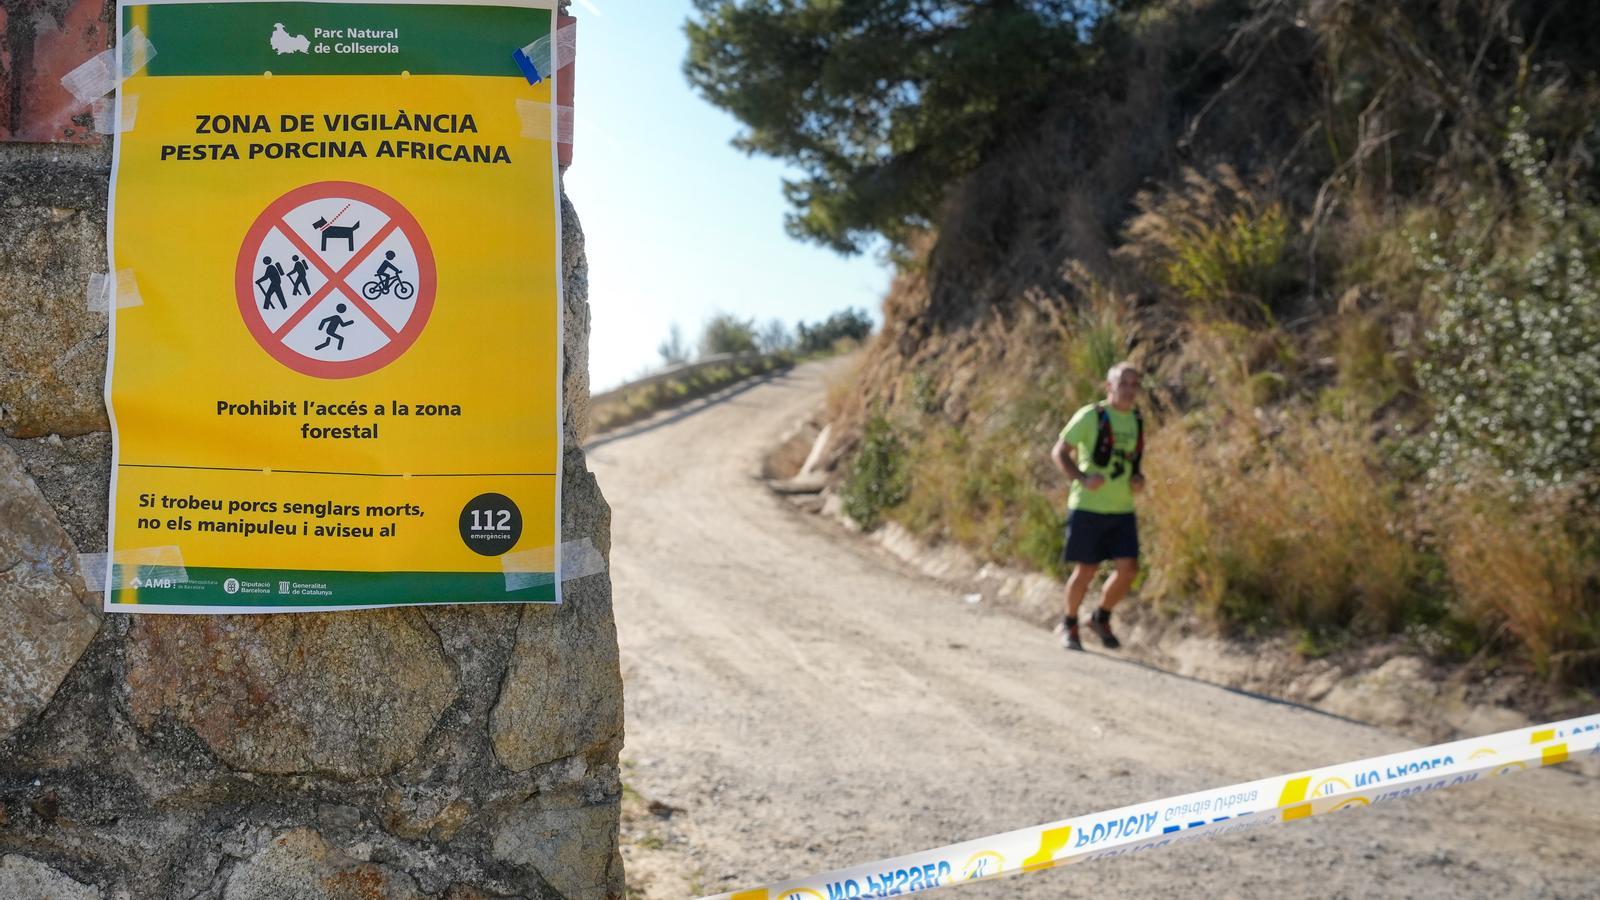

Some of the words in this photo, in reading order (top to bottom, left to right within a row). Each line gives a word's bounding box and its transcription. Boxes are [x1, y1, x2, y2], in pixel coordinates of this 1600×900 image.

[314, 28, 343, 38] Parc
[347, 28, 398, 38] Natural
[314, 42, 331, 53] de
[334, 42, 399, 53] Collserola
[195, 115, 271, 134] ZONA
[280, 114, 315, 132] DE
[323, 109, 478, 133] VIGILÀNCIA
[160, 144, 239, 161] PESTA
[248, 141, 367, 160] PORCINA
[376, 140, 512, 164] AFRICANA
[216, 400, 297, 416] Prohibit
[303, 400, 368, 416] l’accés
[374, 404, 385, 416] a
[392, 400, 409, 416] la
[415, 404, 461, 416] zona
[301, 423, 378, 439] forestal
[138, 494, 155, 508] Si
[161, 495, 223, 511] trobeu
[228, 500, 278, 514] porcs
[282, 501, 360, 518] senglars
[365, 502, 425, 518] morts,
[137, 516, 161, 529] no
[166, 517, 192, 531] els
[197, 520, 297, 537] manipuleu
[303, 521, 308, 536] i
[314, 523, 374, 538] aviseu
[379, 523, 396, 537] al
[470, 509, 511, 531] 112
[470, 532, 511, 541] emergències
[144, 578, 171, 589] AMB
[292, 582, 327, 590] Generalitat
